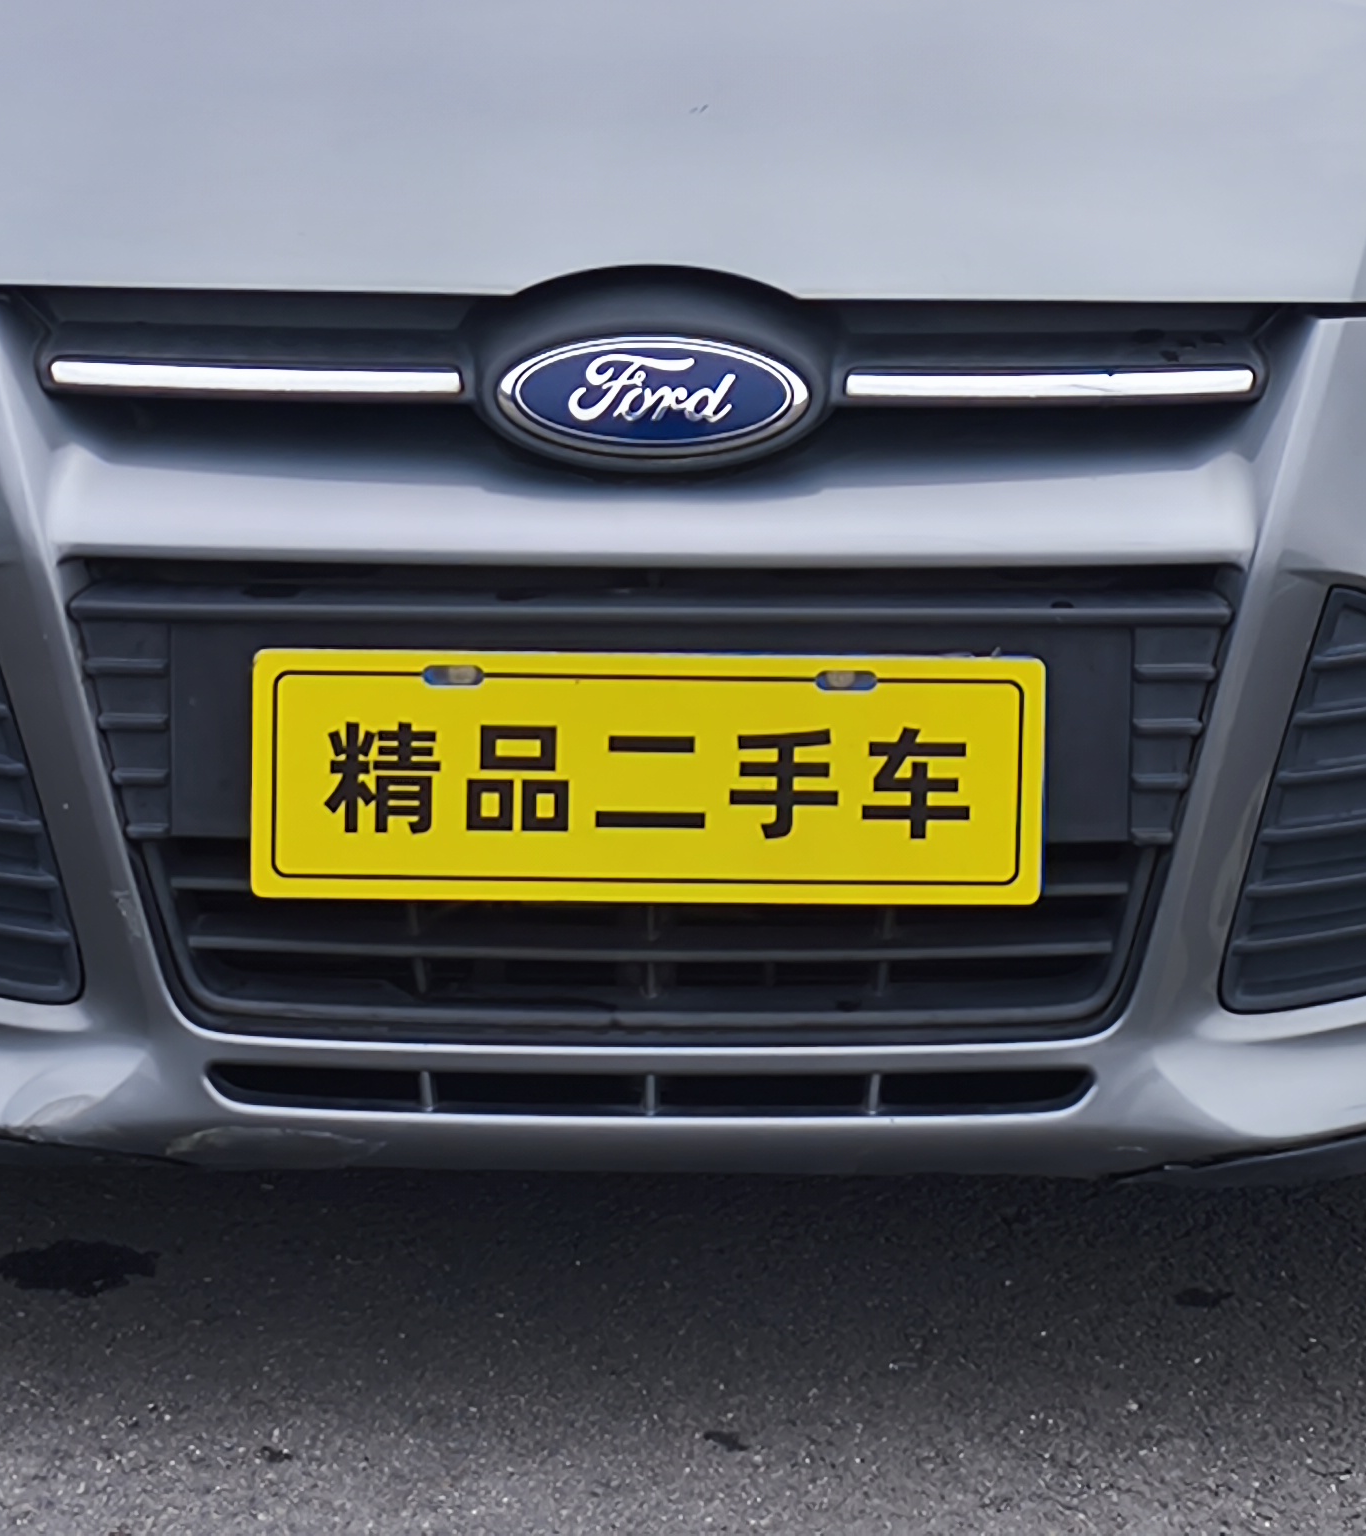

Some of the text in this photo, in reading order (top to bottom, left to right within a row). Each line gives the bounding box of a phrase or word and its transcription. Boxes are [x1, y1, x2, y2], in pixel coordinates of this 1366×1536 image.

[568, 353, 737, 422] Ford
[323, 722, 971, 840] 精品二手车
